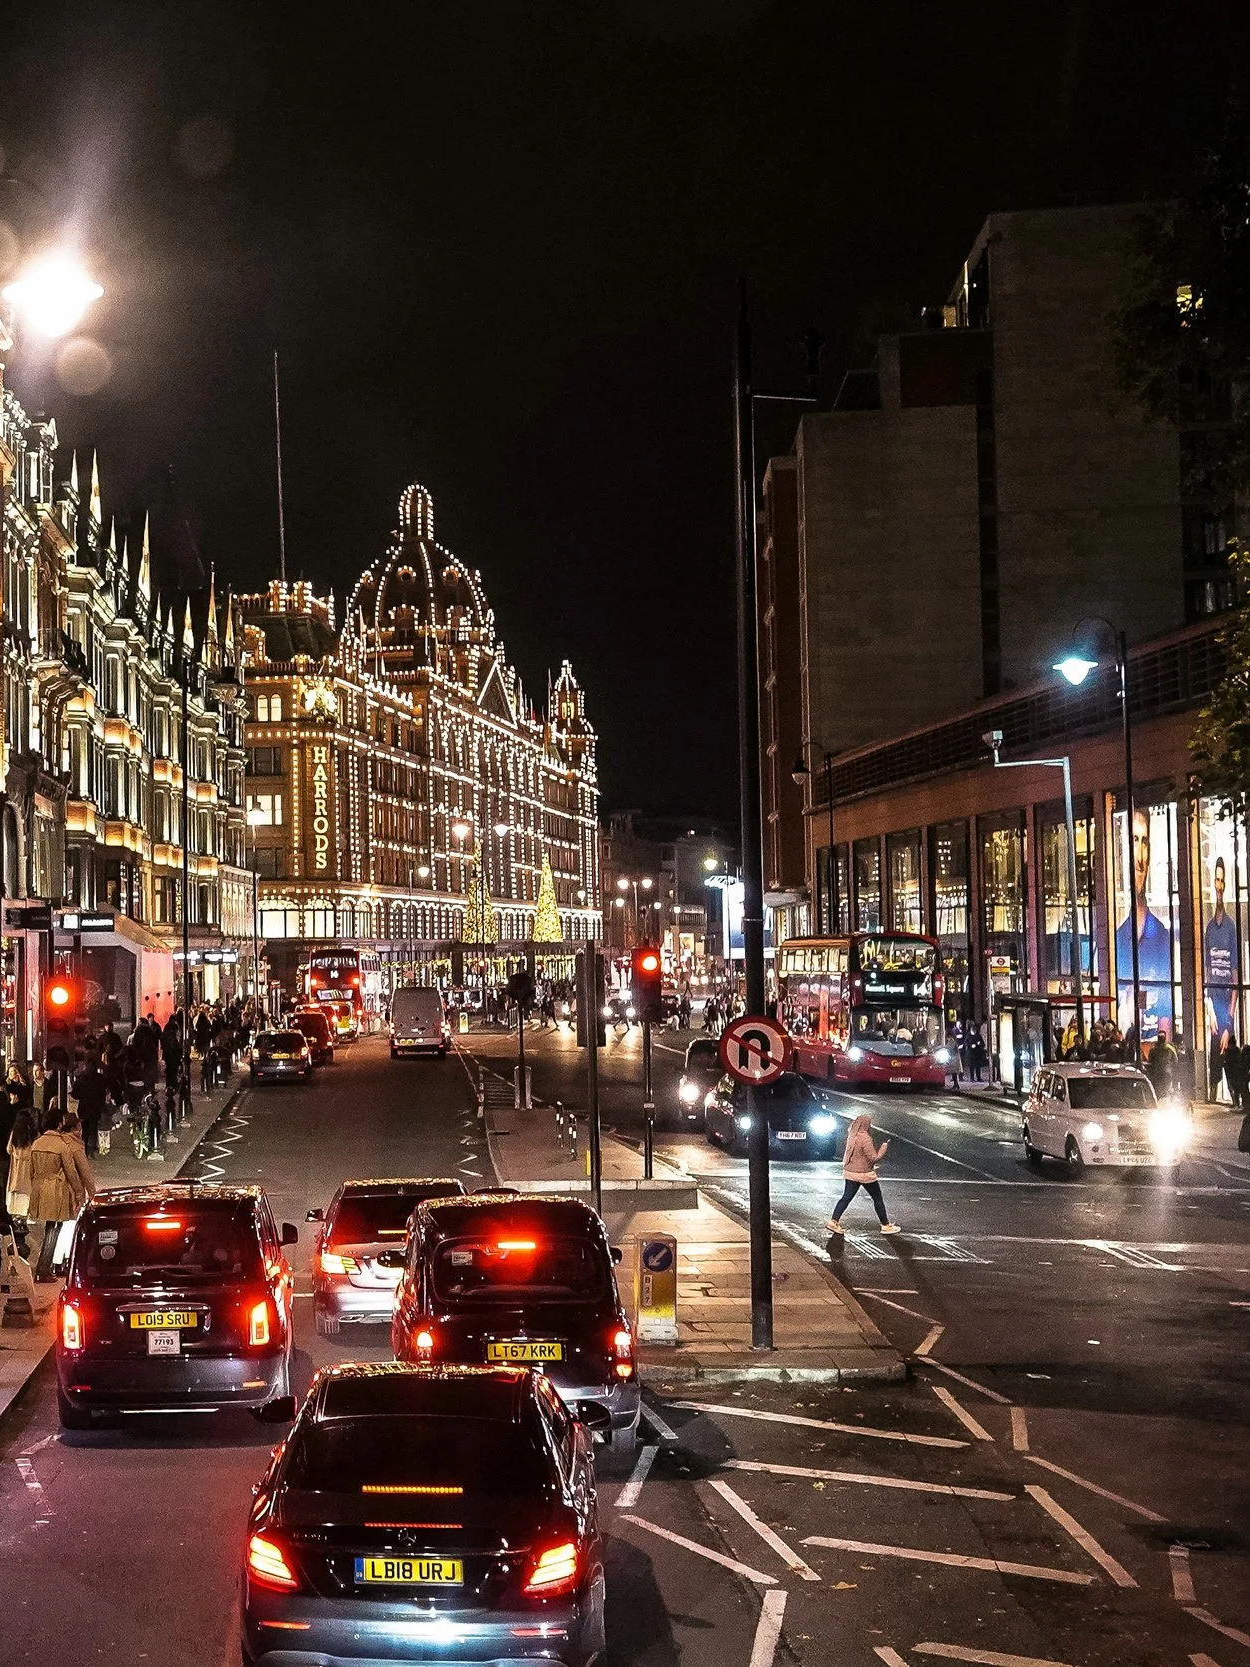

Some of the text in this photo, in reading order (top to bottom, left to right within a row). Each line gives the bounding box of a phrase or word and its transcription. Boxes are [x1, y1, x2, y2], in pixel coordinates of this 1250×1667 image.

[313, 746, 329, 869] HARRODS
[137, 1312, 190, 1326] LO19 SRU
[154, 1338, 174, 1346] 77193
[493, 1345, 556, 1358] LT67 KRK
[371, 1561, 413, 1579] LB18
[419, 1562, 456, 1580] URJ
